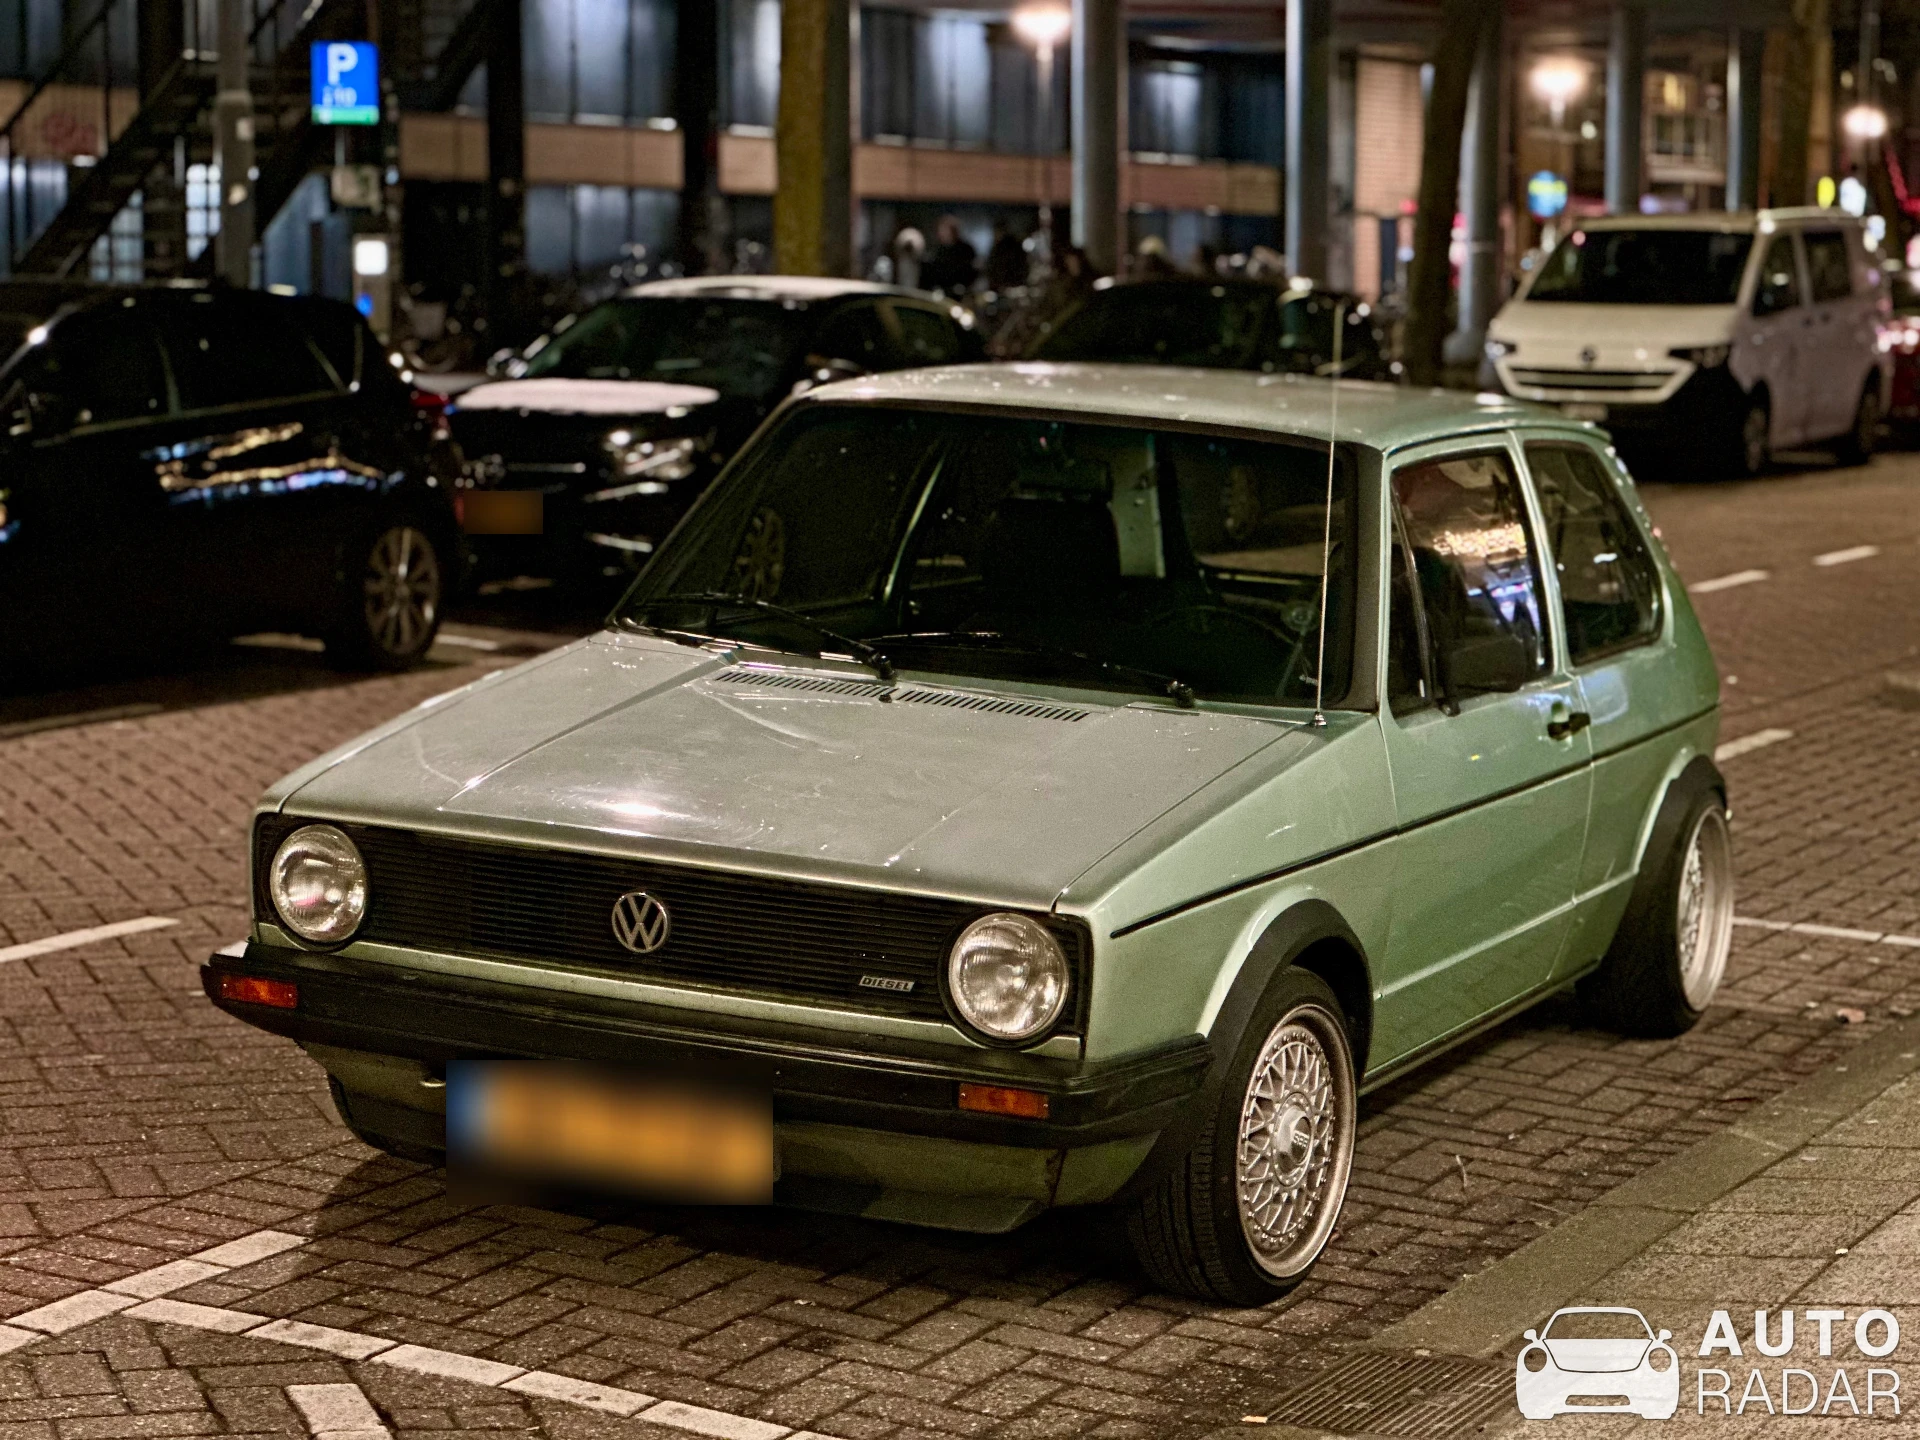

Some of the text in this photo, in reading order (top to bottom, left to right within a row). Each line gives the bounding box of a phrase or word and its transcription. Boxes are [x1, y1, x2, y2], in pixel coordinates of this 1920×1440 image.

[327, 43, 358, 85] P
[612, 892, 668, 953] VW
[861, 977, 911, 991] DIESEL
